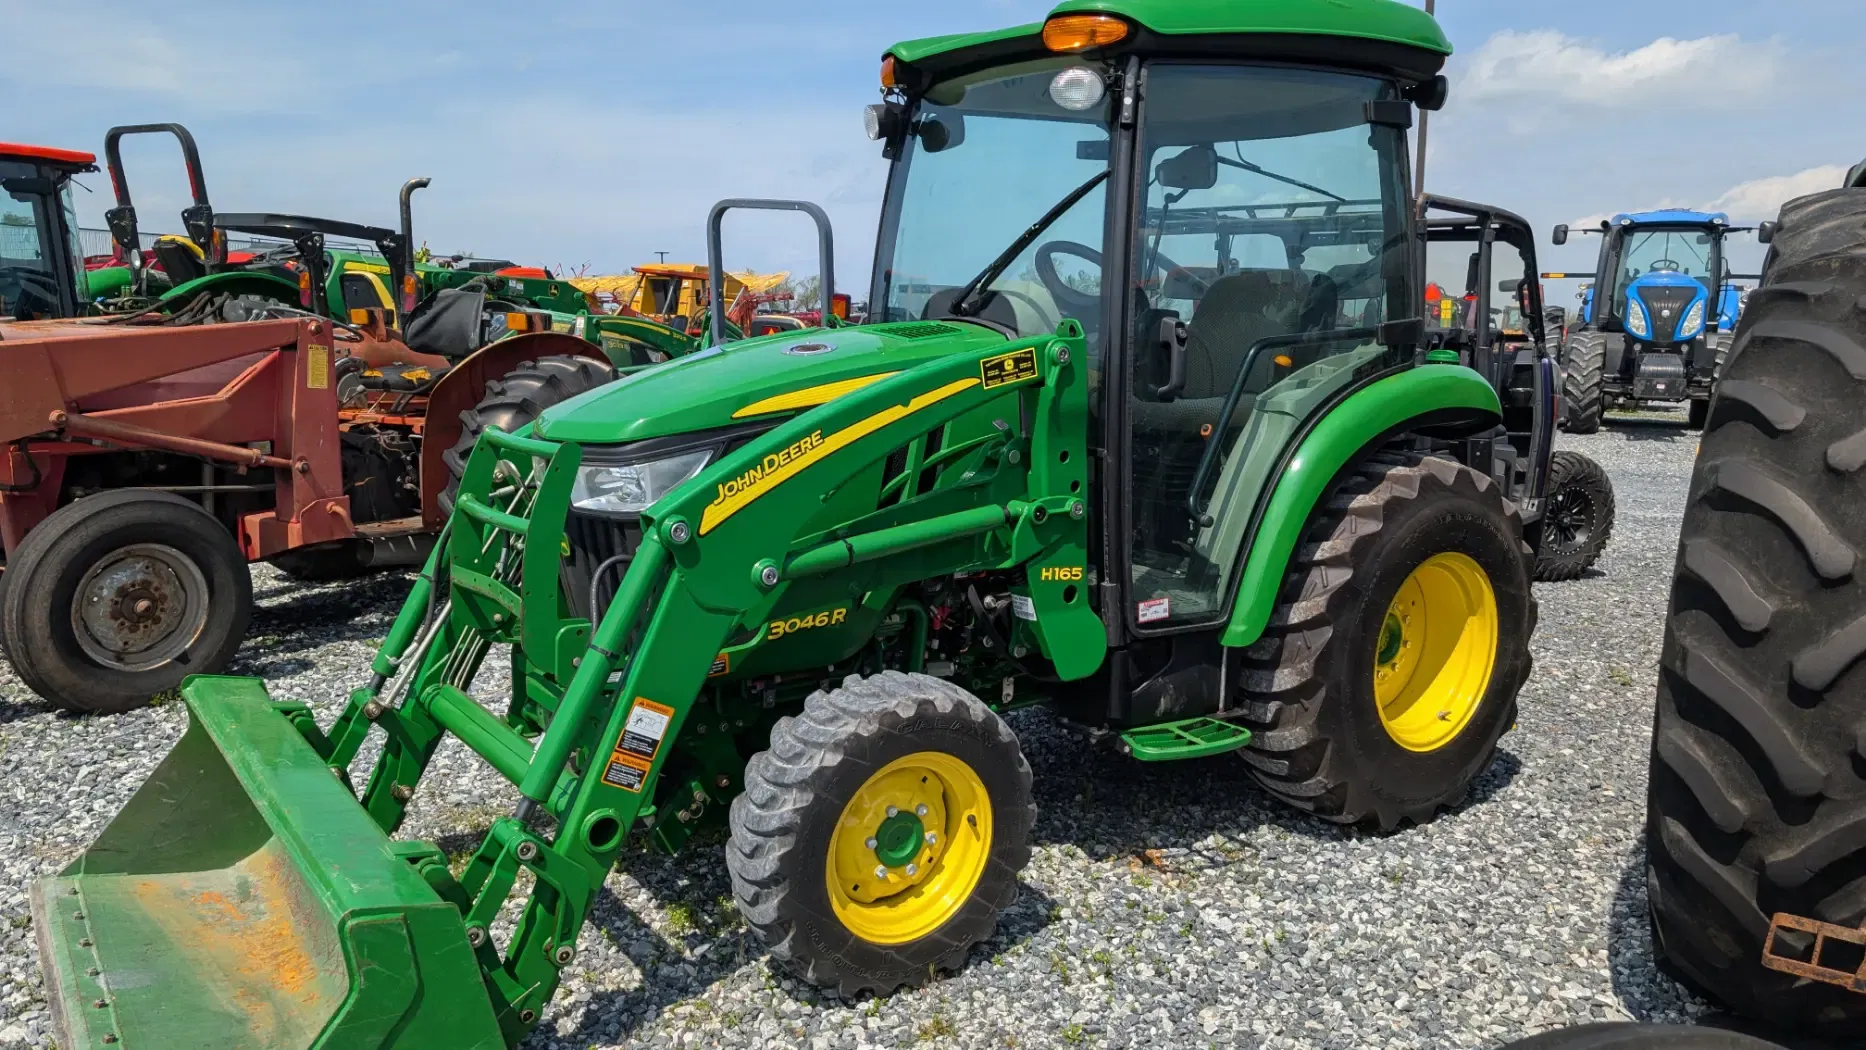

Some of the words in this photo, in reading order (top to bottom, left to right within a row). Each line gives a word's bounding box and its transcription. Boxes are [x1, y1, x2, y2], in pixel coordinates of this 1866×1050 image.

[713, 465, 764, 506] JOHN
[763, 430, 825, 476] DEERE
[1041, 567, 1083, 581] H165
